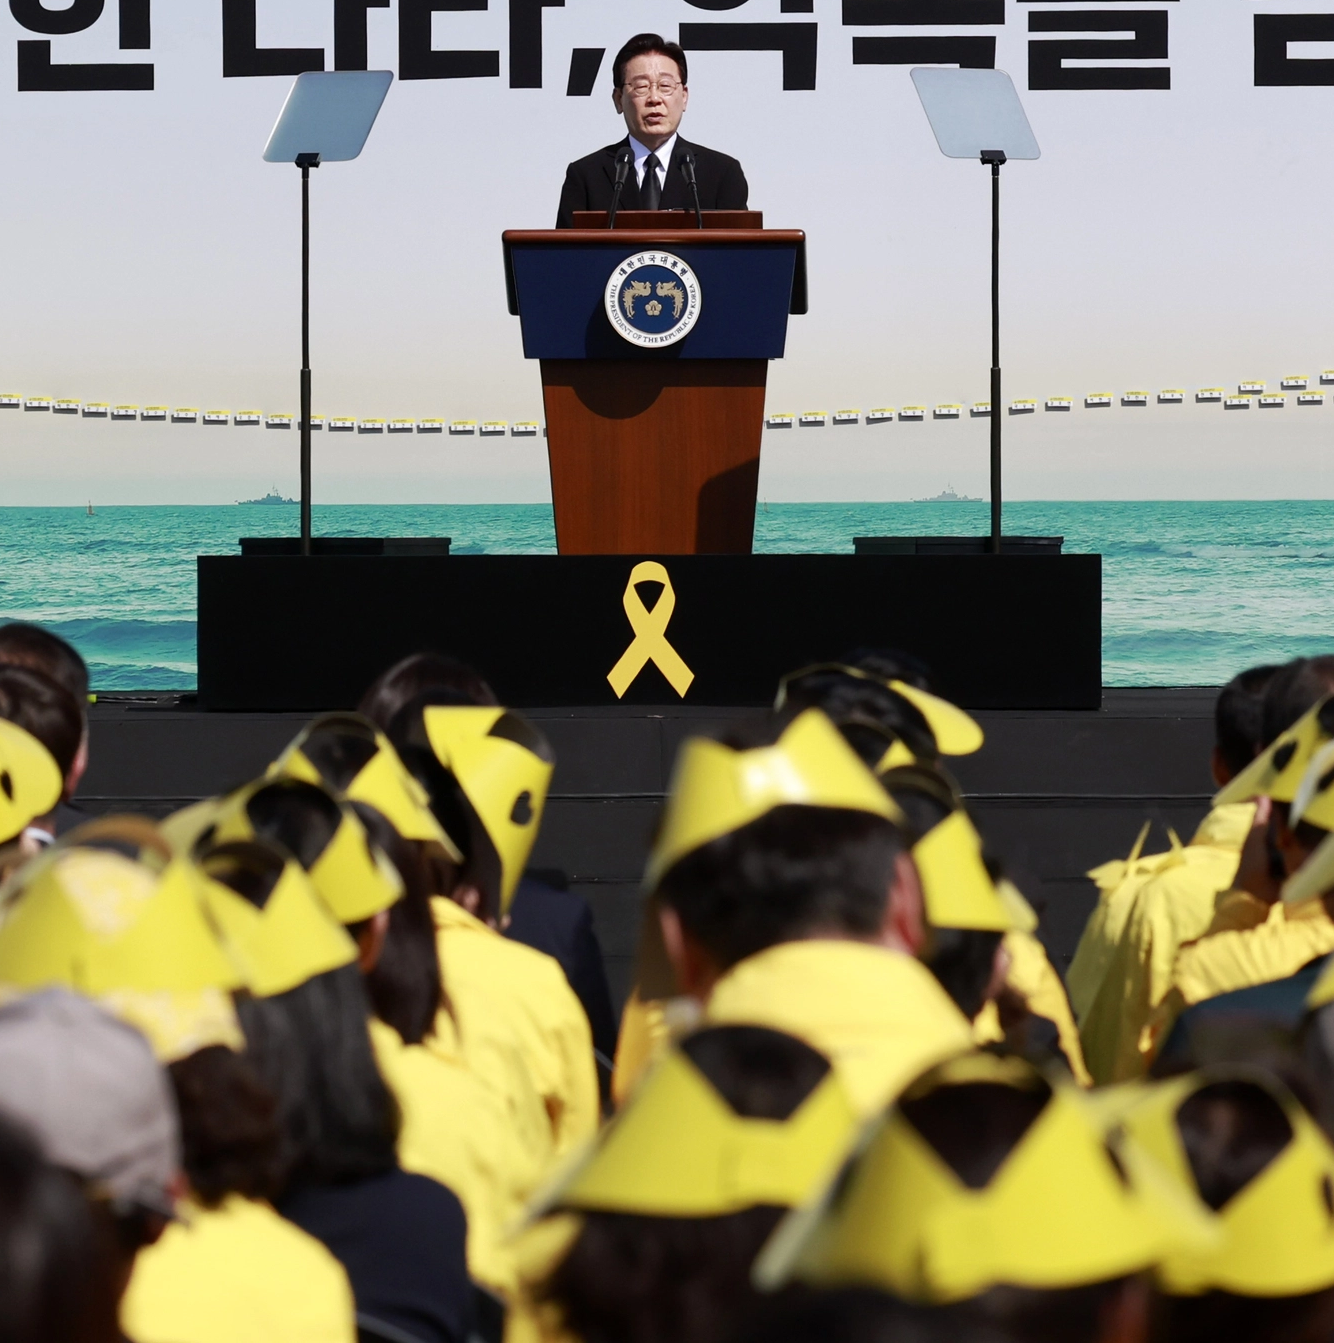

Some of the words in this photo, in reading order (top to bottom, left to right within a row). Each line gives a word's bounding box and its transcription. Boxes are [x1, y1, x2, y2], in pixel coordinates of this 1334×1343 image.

[610, 284, 618, 299] THE
[689, 284, 697, 309] KOREA
[610, 300, 633, 335] PRESIDENT
[687, 310, 694, 320] OF
[632, 332, 642, 340] OF
[659, 319, 690, 343] REPUBLIC
